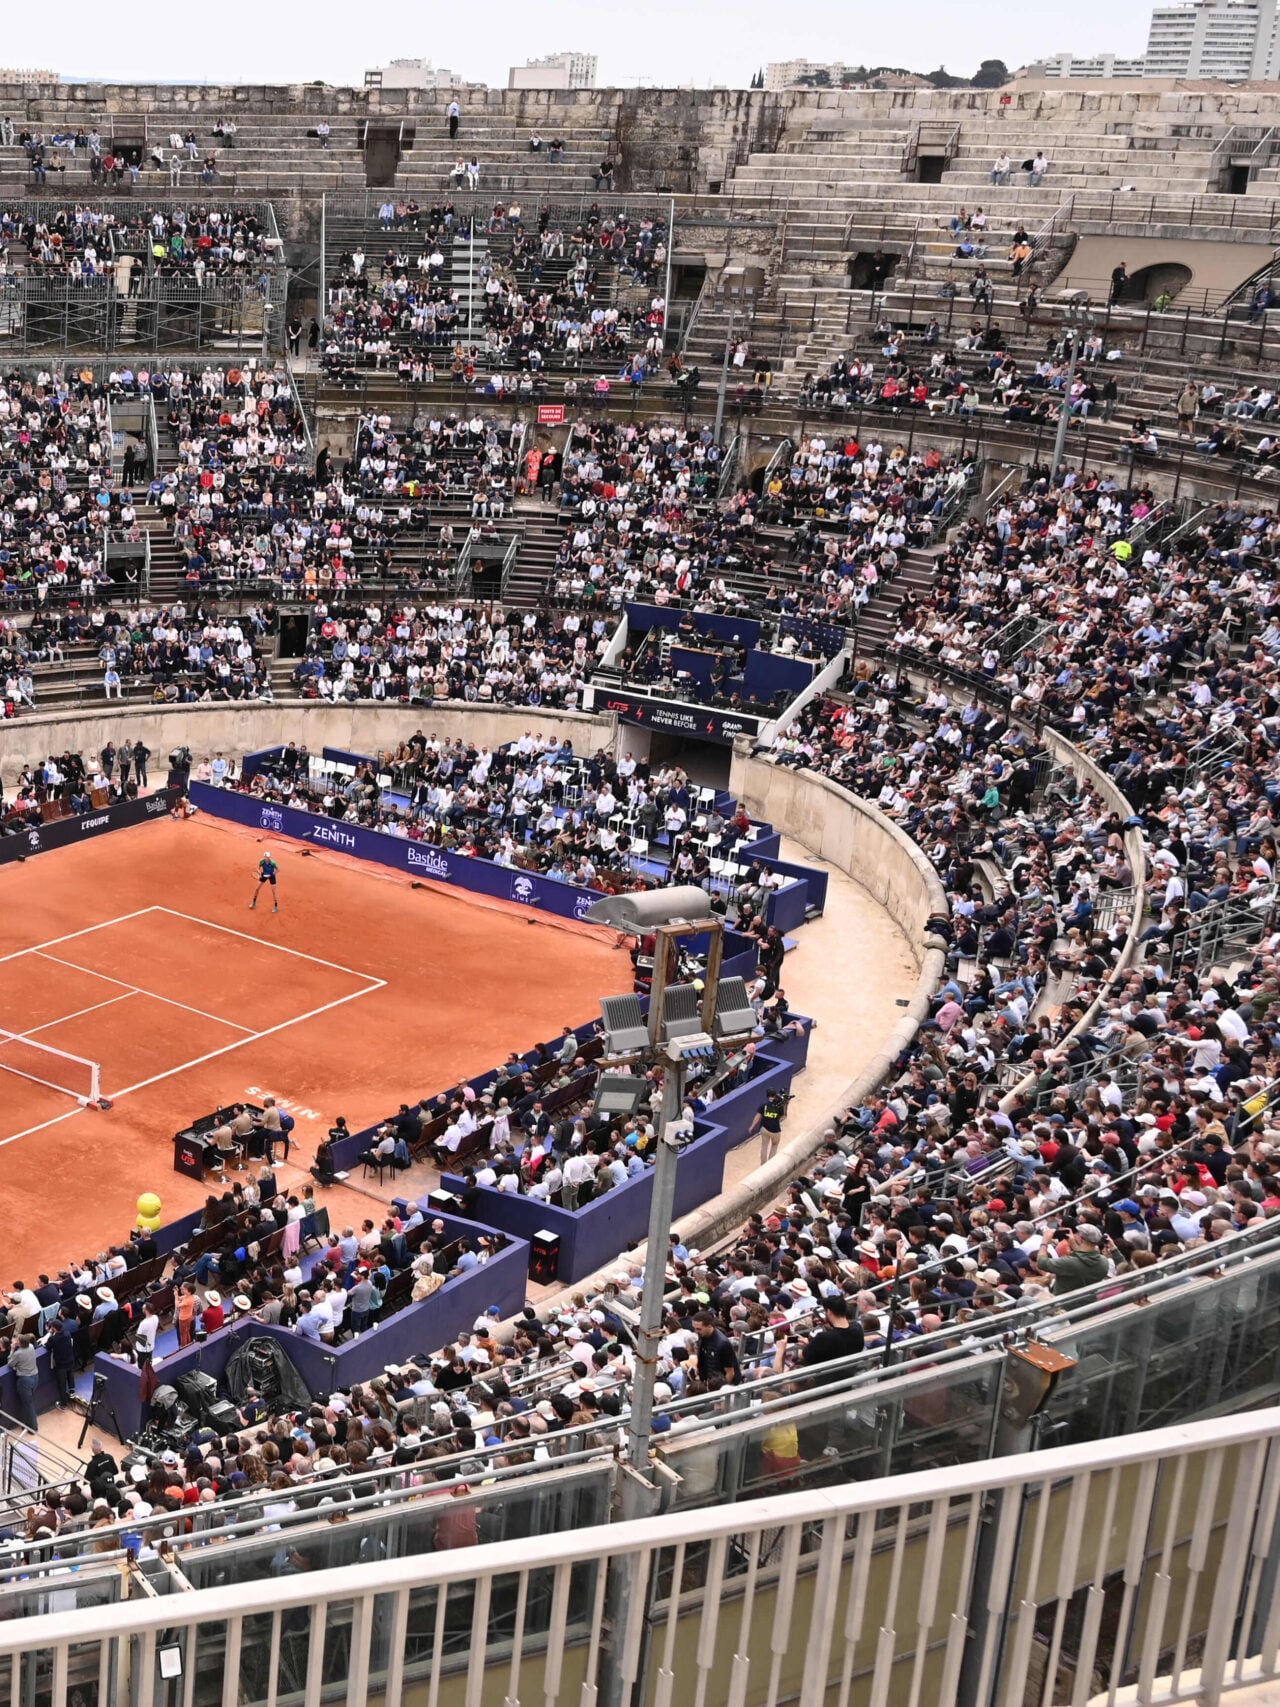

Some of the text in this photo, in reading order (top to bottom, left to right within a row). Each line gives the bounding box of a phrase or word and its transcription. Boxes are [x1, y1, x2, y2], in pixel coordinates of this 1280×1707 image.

[607, 701, 630, 712] UTS
[656, 709, 694, 722] TENNIS LIKE
[651, 716, 697, 730] NEVER BEFORE
[313, 824, 355, 848] ZENITH
[407, 847, 448, 869] Bastide
